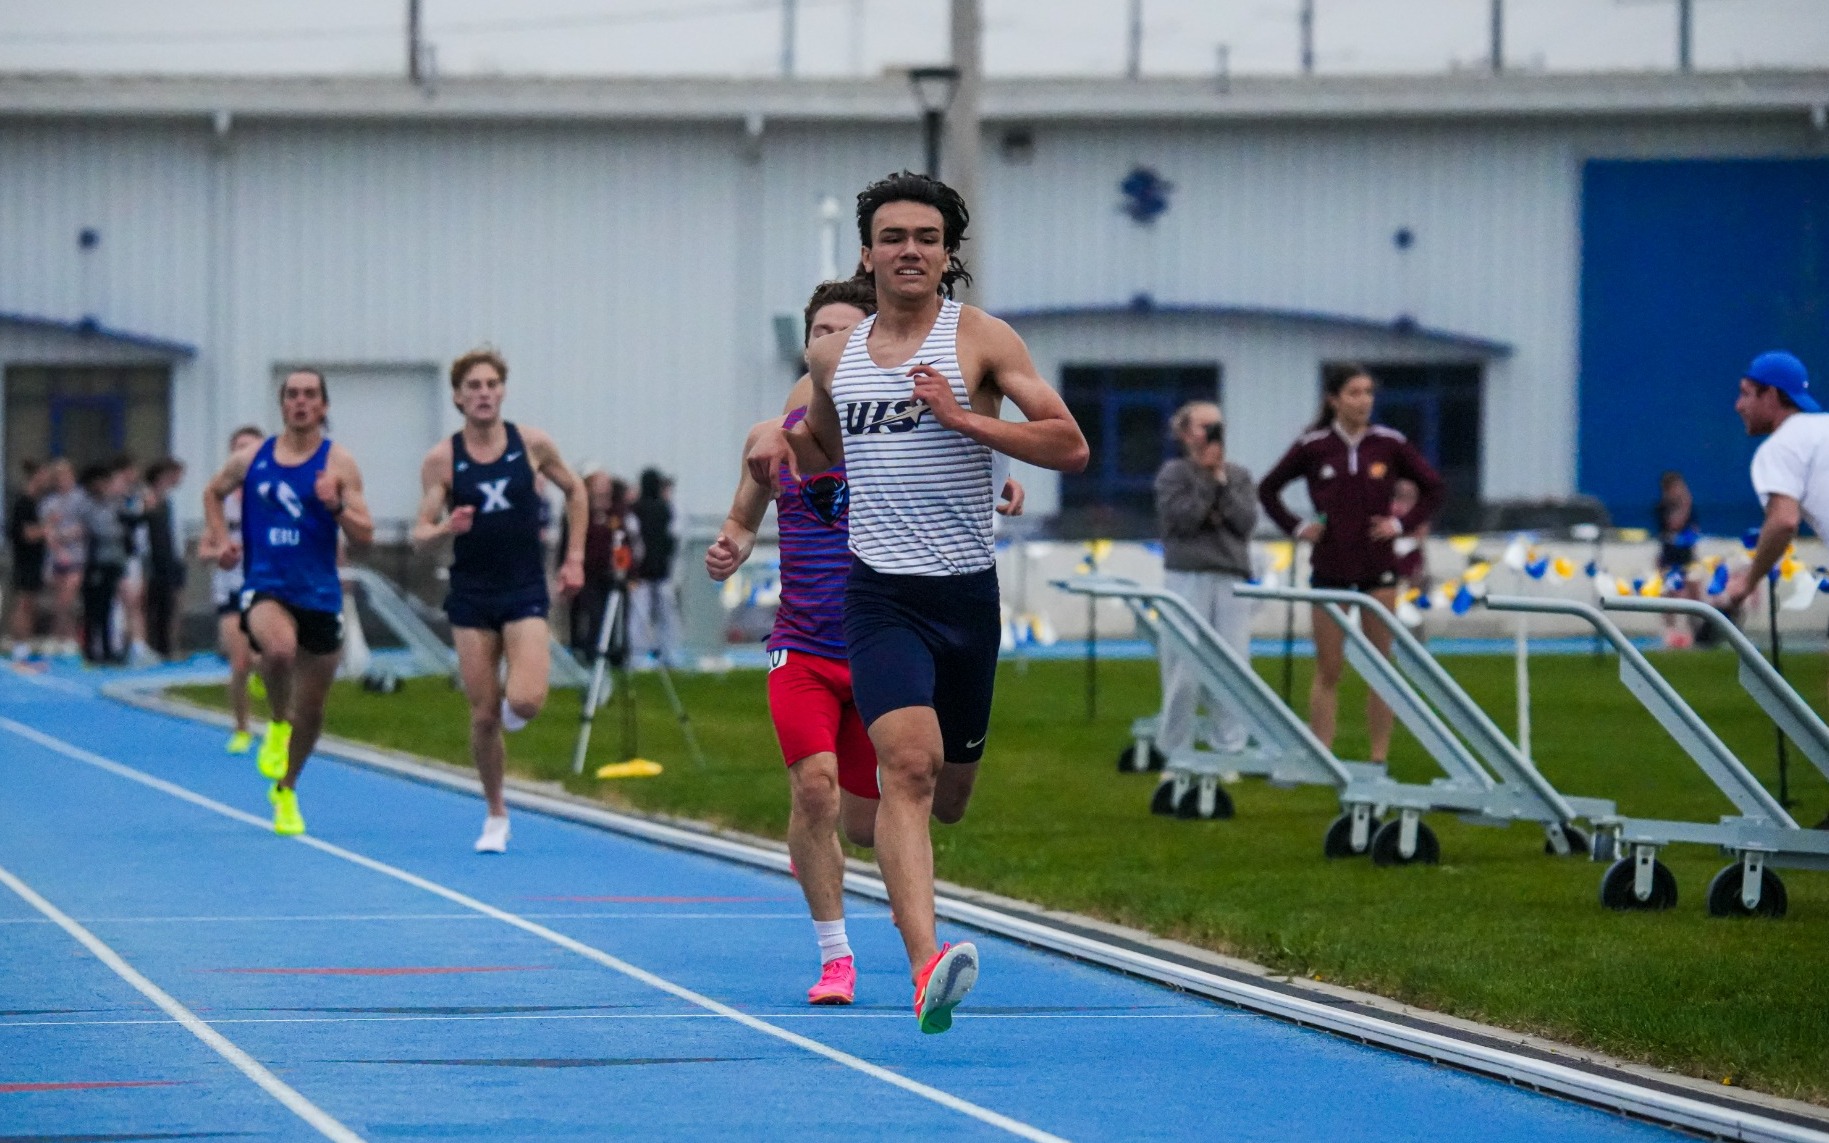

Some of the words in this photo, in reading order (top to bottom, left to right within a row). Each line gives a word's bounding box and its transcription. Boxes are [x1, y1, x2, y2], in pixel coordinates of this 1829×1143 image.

[846, 401, 917, 435] UIS
[478, 478, 512, 513] X
[269, 528, 300, 546] EIU
